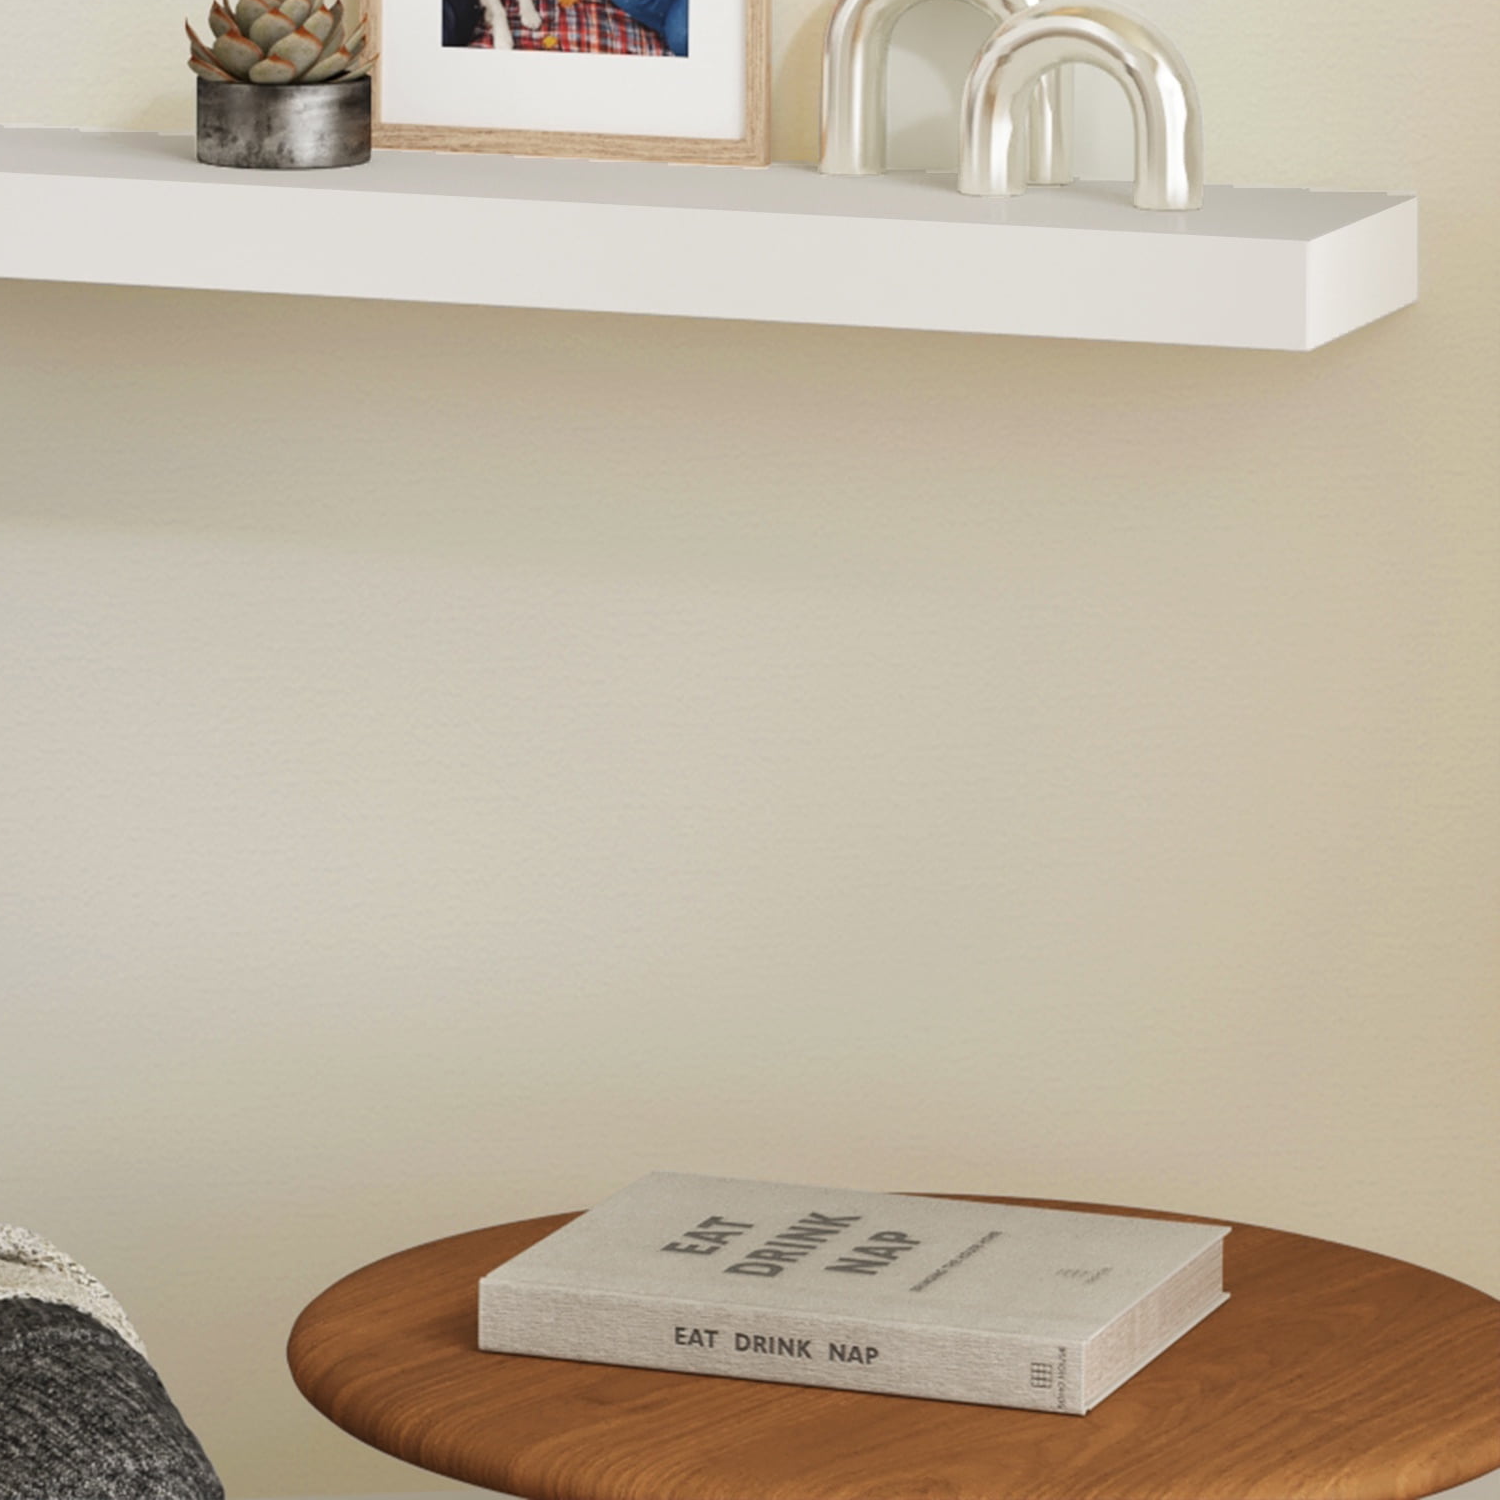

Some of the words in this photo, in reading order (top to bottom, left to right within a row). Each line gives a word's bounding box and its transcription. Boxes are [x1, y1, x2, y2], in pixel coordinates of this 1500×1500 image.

[658, 1215, 755, 1256] EAT
[722, 1211, 863, 1278] DRINK
[823, 1231, 922, 1275] NAP
[674, 1326, 719, 1348] EAT
[734, 1332, 813, 1359] DRINK
[828, 1342, 880, 1365] NAP
